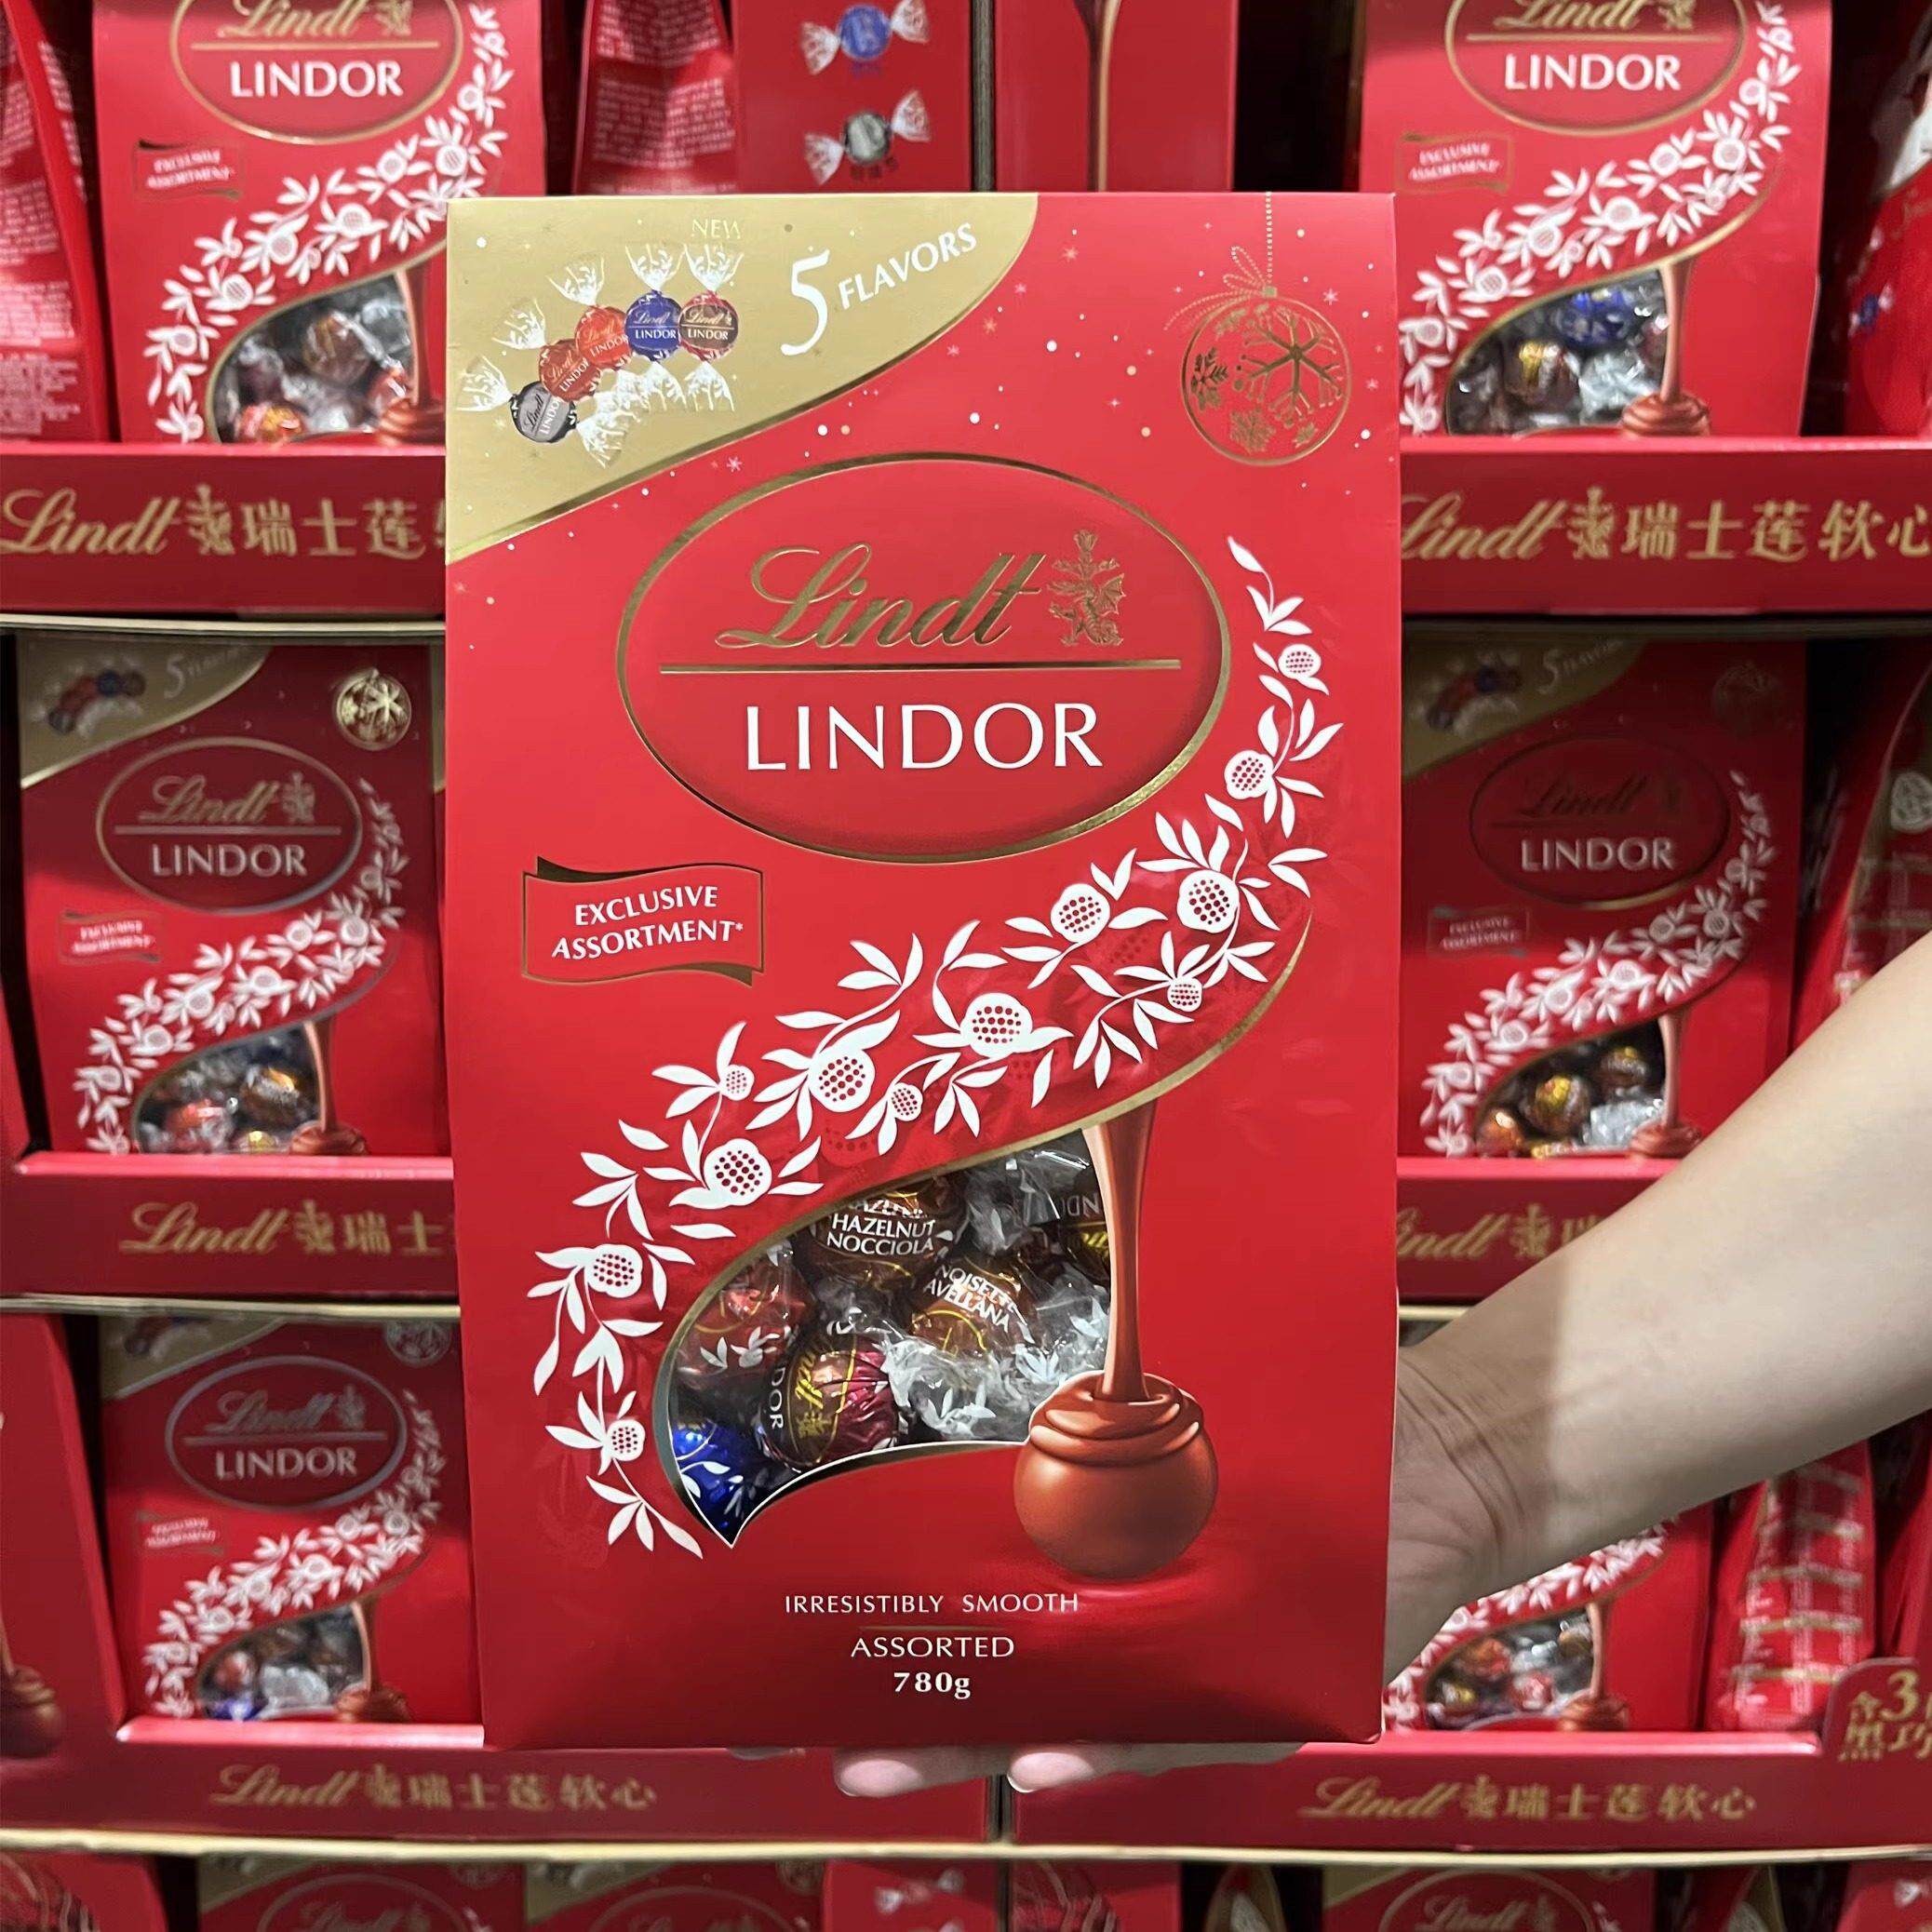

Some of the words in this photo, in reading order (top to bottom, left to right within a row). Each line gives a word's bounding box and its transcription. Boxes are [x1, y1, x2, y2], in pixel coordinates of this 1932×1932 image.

[230, 60, 403, 98] LINDOR
[1504, 53, 1681, 91] LINDOR
[691, 218, 741, 239] NEW
[780, 248, 830, 356] 5
[838, 222, 978, 310] FLAVORS
[635, 329, 677, 340] LINDOR
[687, 329, 729, 341] LINDOR
[540, 401, 560, 435] LINDO
[0, 489, 181, 557] Lindt
[240, 497, 446, 559] 瑞士莲
[1401, 490, 1566, 559] Lindt
[1621, 499, 1932, 563] 瑞士莲软心
[715, 543, 1046, 648] Lindt
[746, 703, 1103, 771] LINDOR
[138, 775, 281, 825] Lindt
[151, 843, 307, 877] LINDOR
[1522, 837, 1675, 872] LINDOR
[575, 885, 718, 926] EXCLUSIVE
[120, 1201, 289, 1254] Lindt
[343, 1209, 454, 1254] 瑞士
[826, 1231, 933, 1255] NOCCIOLA
[831, 1213, 936, 1239] HAZELNUT
[923, 1278, 1010, 1334] AVELLANA
[769, 1367, 785, 1429] DOR
[216, 1446, 357, 1481] LINDOR
[785, 1594, 945, 1614] IRRESISTIBLY
[962, 1593, 1079, 1614] SMOOTH
[851, 1637, 1014, 1657] ASSORTED
[893, 1671, 972, 1699] 780g
[1847, 1670, 1932, 1722] 含3
[209, 1766, 365, 1807] Lindt
[406, 1773, 657, 1811] 瑞士莲软心
[1299, 1777, 1463, 1820] Lindt
[1506, 1783, 1757, 1822] 瑞士莲软心
